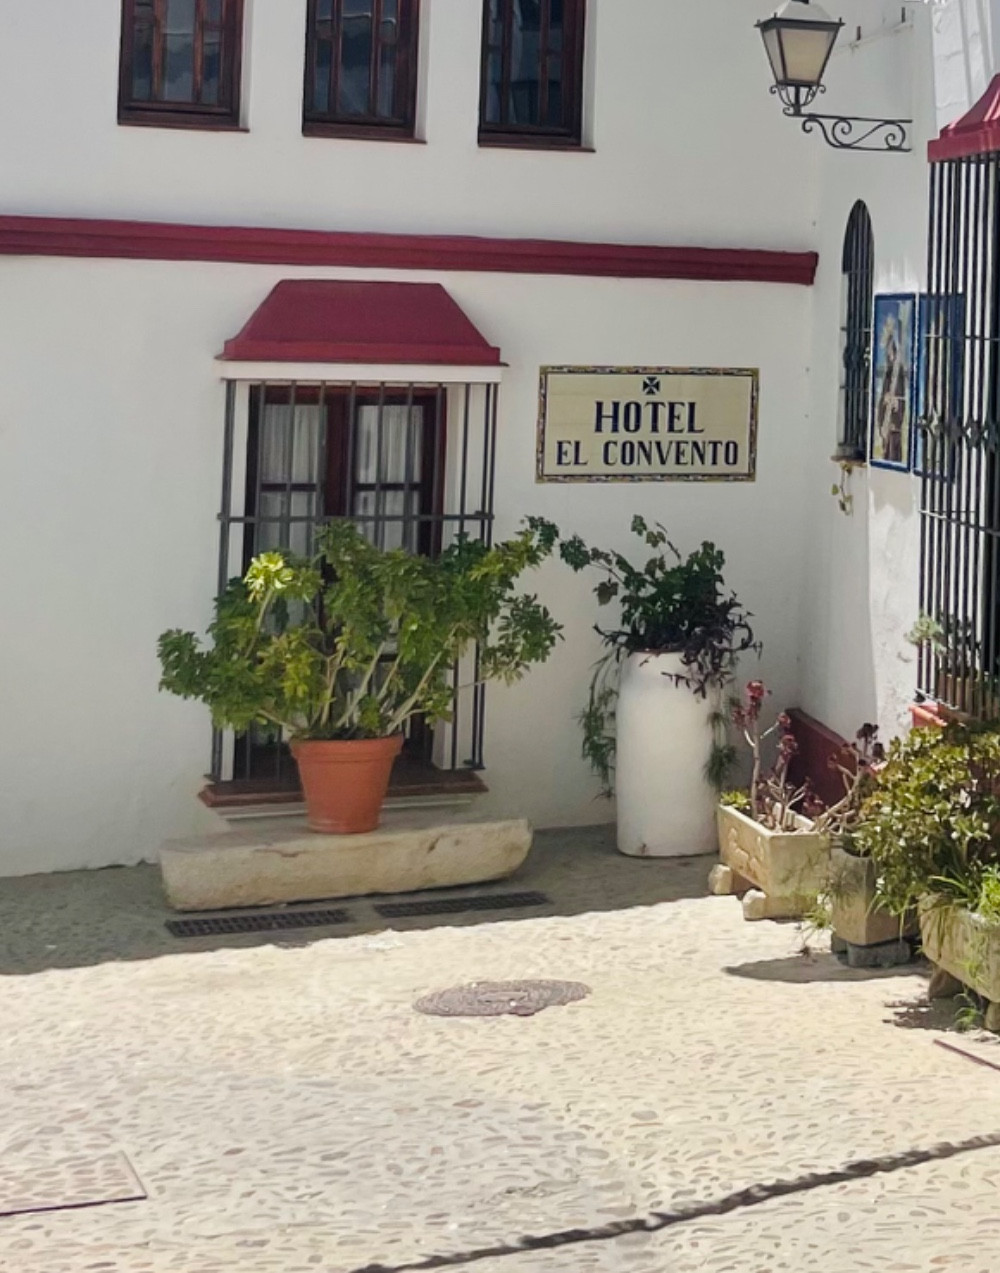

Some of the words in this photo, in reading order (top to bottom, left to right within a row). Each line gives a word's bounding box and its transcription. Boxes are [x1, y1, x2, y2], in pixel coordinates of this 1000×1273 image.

[593, 401, 705, 434] HOTEL
[555, 440, 588, 466] EL
[602, 440, 739, 466] CONVENTO
